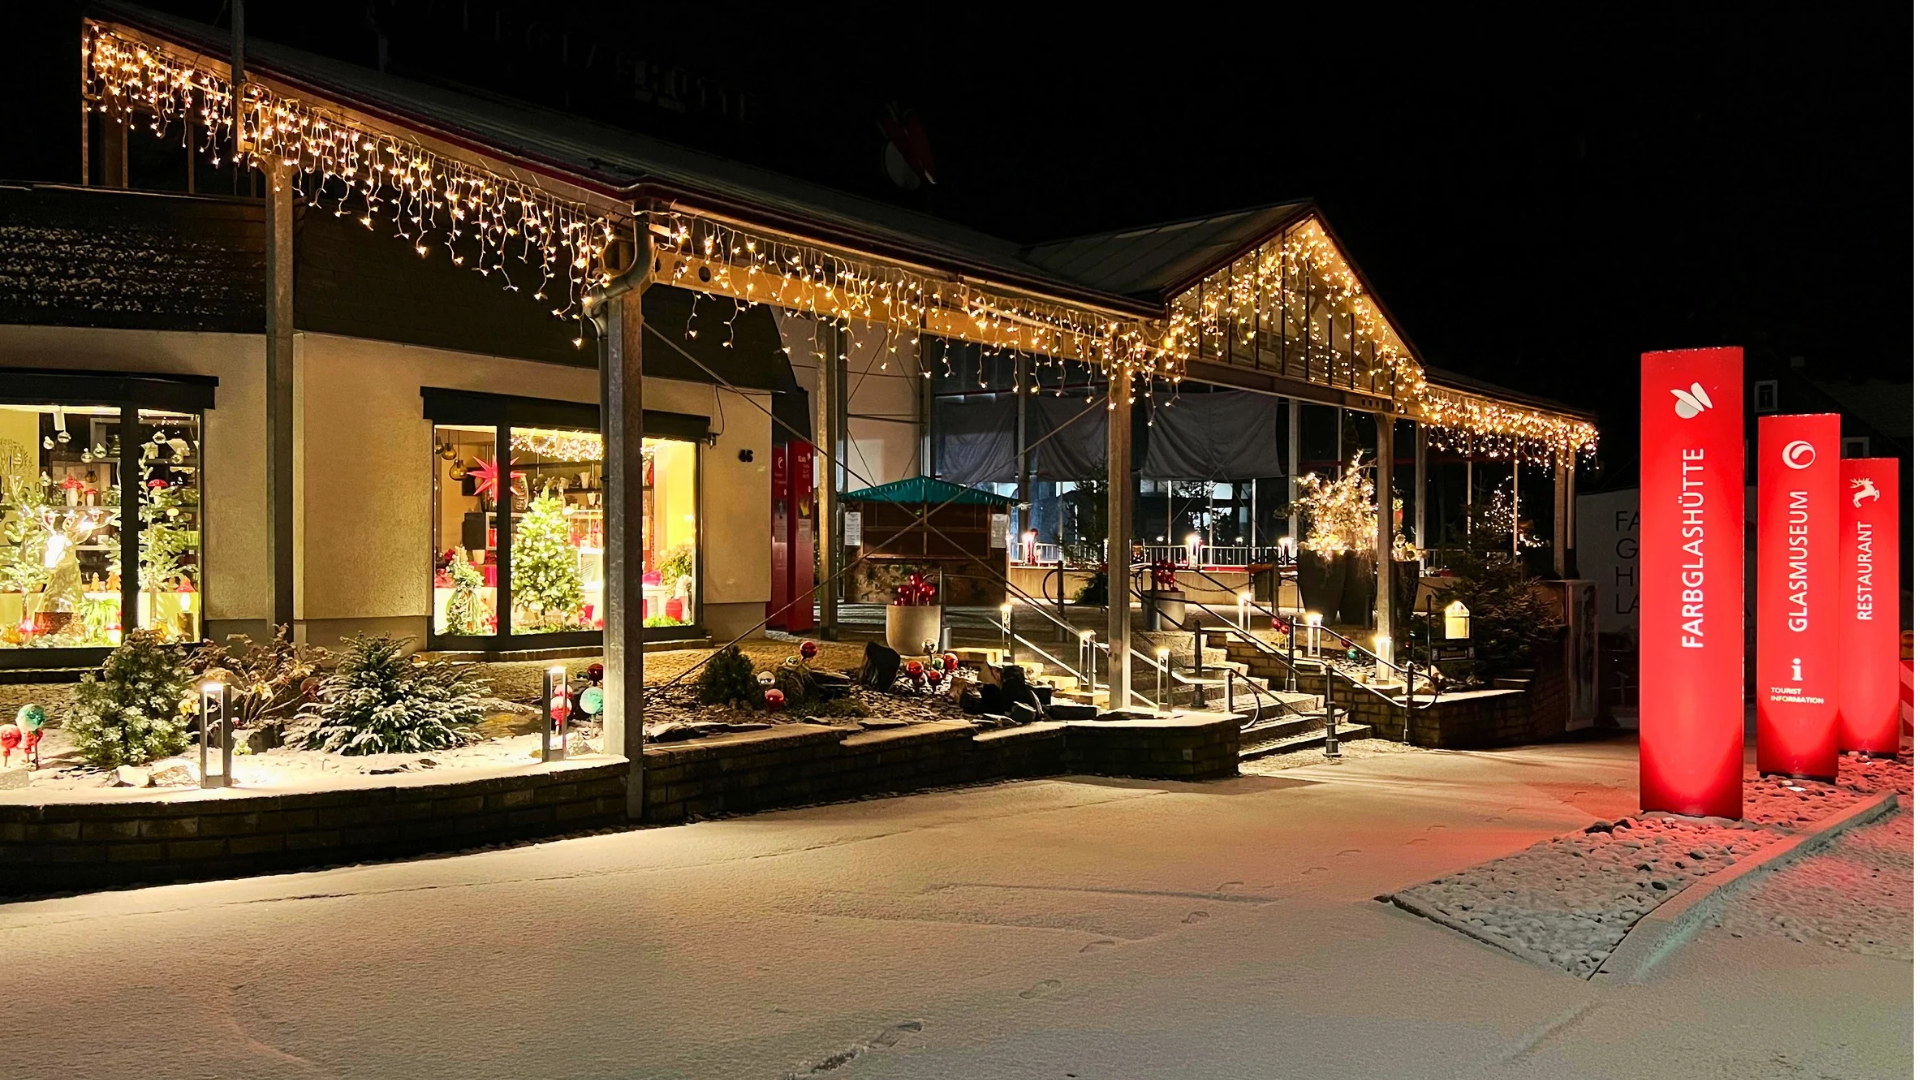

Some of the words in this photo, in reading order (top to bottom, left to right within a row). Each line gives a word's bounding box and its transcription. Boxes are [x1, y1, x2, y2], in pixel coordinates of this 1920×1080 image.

[1615, 511, 1640, 531] FA
[1615, 537, 1639, 560] G
[1678, 448, 1704, 648] FARBGLASHÜTTE
[1788, 491, 1808, 632] GLASMUSEUM
[1857, 521, 1872, 620] RESTAURANT
[1615, 566, 1640, 587] H
[1615, 593, 1640, 614] LA
[1770, 687, 1802, 695] TOURIST
[1770, 696, 1825, 704] INFORMATION
